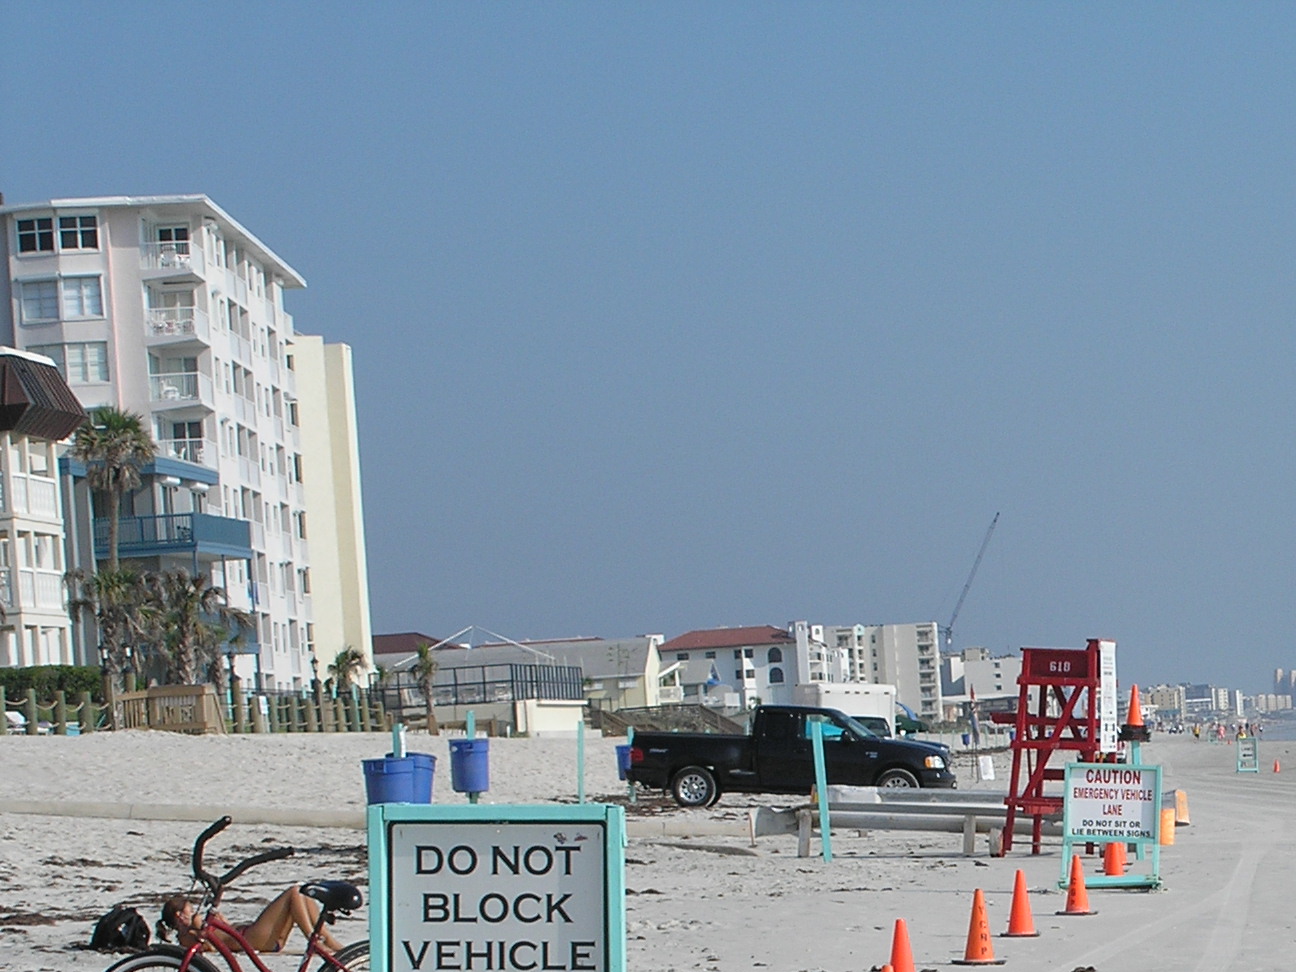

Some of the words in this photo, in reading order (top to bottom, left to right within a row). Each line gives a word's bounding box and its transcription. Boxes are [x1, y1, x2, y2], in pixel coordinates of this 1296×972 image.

[1086, 769, 1141, 784] CAUTION
[1073, 787, 1119, 800] EMERGENCY
[1121, 788, 1153, 801] VEHICLE
[1102, 804, 1123, 816] LANE
[1082, 819, 1094, 827] DO
[1095, 820, 1112, 828] NOT
[1071, 828, 1086, 836] LIE
[1086, 828, 1125, 837] BETWEEN
[1126, 830, 1151, 838] SIGNS
[415, 845, 478, 875] DO
[491, 845, 581, 875] NOT
[423, 893, 573, 924] BLOCK
[402, 940, 597, 971] VEHICLE
